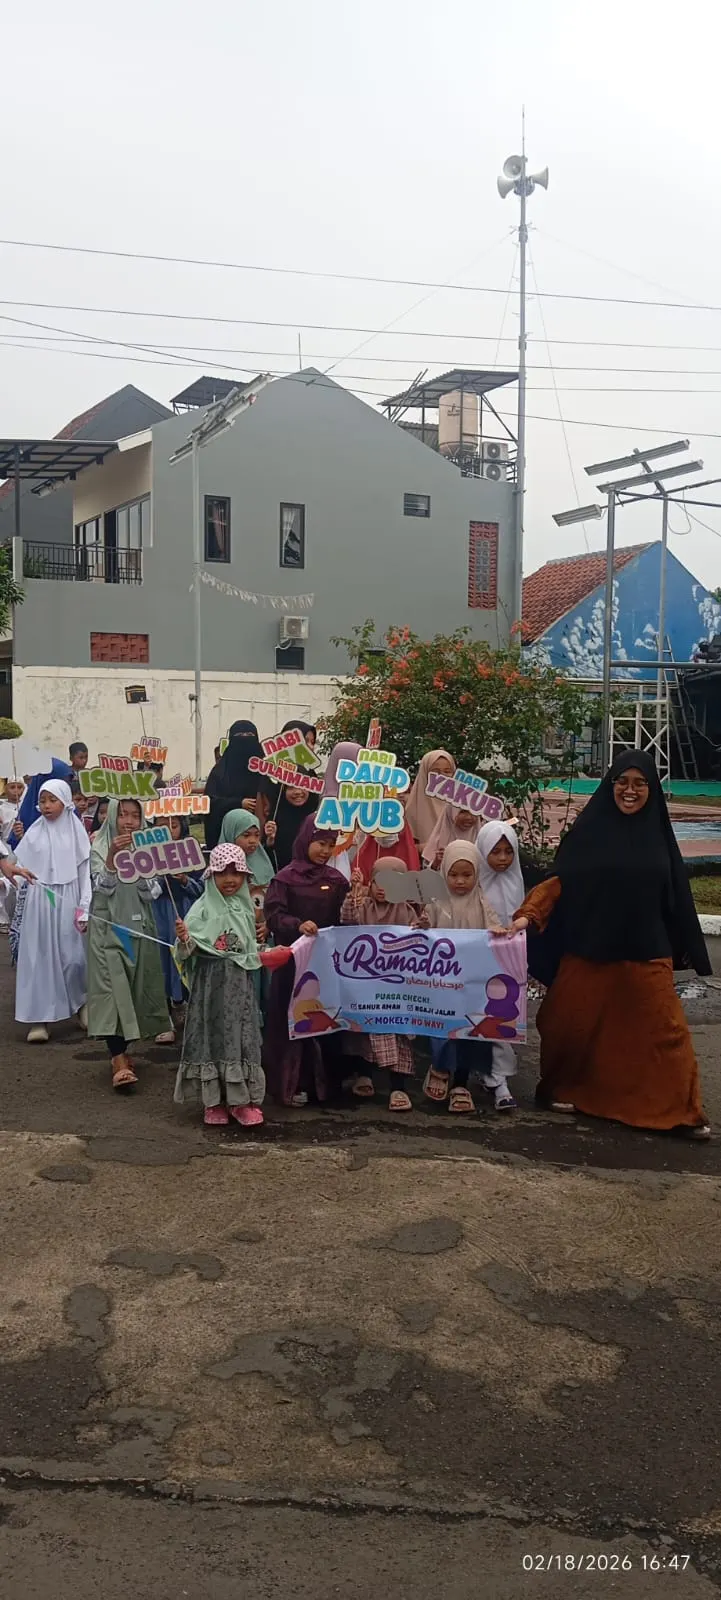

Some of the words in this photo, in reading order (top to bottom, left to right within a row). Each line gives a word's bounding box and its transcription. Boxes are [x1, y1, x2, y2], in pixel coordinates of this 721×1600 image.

[80, 770, 156, 796] ISHAK
[249, 757, 324, 792] SULAIMAN
[337, 760, 407, 789] DAUD
[426, 774, 502, 819] YAKUB
[316, 799, 402, 828] AYUB
[115, 839, 200, 879] SOLEH
[343, 934, 462, 977] Ramadan
[375, 993, 401, 1001] PUASA
[375, 1016, 409, 1025] MOKEL?
[411, 1017, 423, 1026] NO
